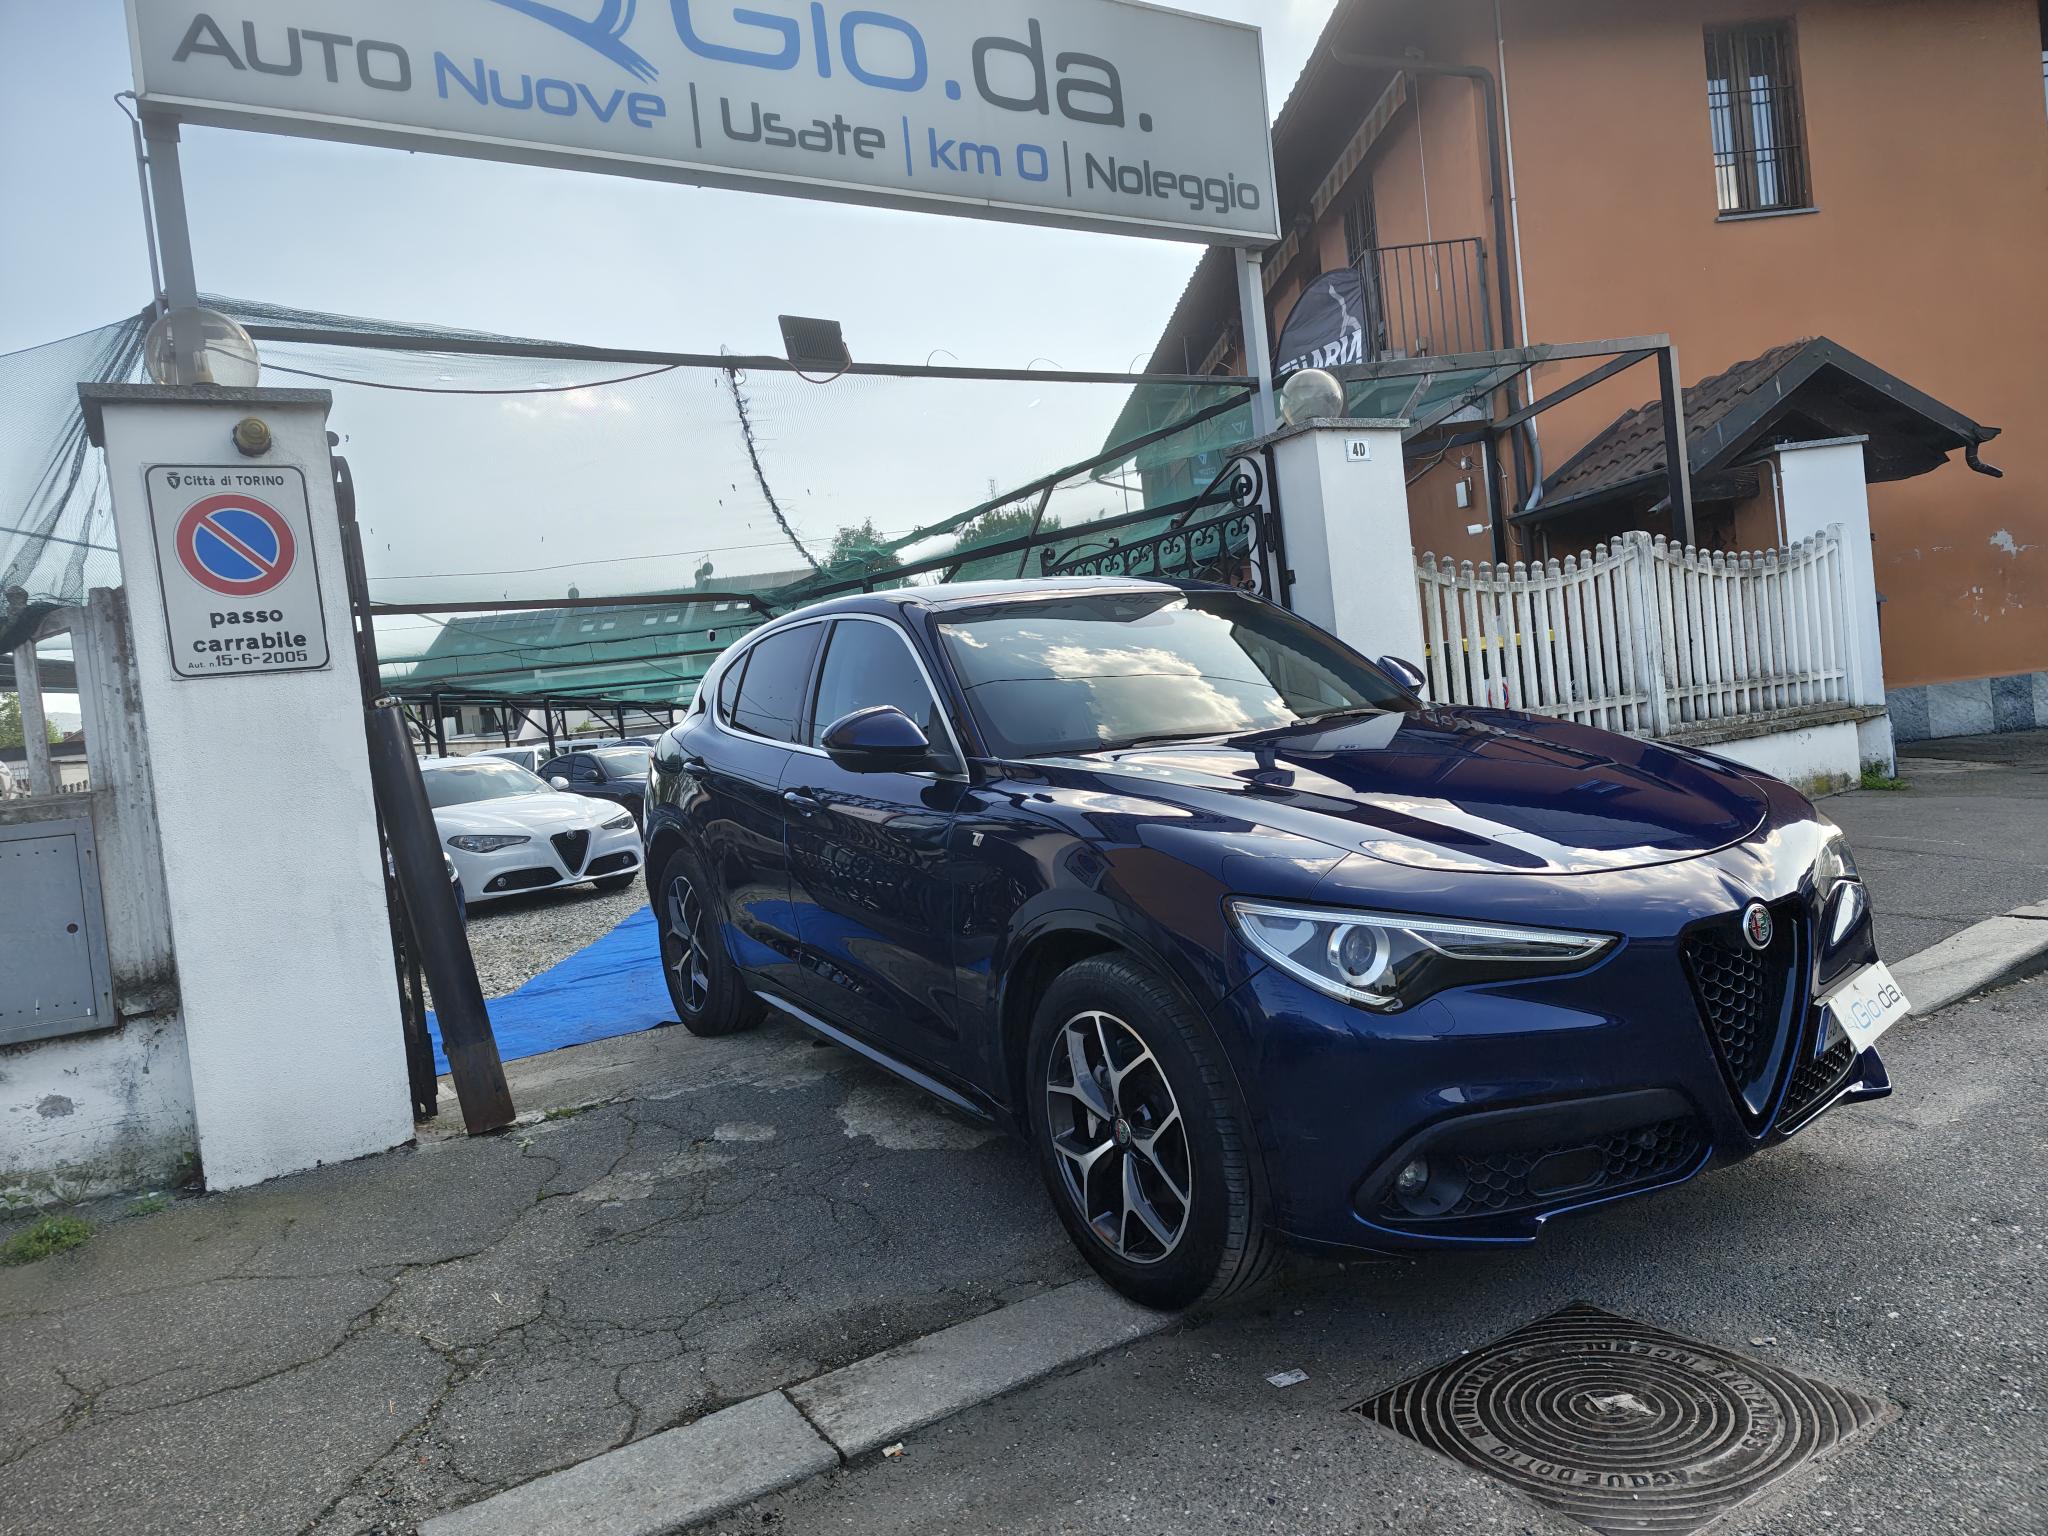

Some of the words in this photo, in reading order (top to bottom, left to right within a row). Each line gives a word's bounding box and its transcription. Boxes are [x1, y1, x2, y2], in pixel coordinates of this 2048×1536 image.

[172, 13, 412, 92] AUTO
[433, 51, 667, 129] Nuove
[719, 97, 886, 160] Usate
[928, 127, 1002, 178] km
[1085, 152, 1260, 214] Noleggio
[1352, 442, 1366, 456] 4D
[221, 475, 232, 486] di
[235, 475, 284, 486] TORINO
[209, 609, 284, 628] passo
[192, 631, 307, 653] carrabile
[188, 661, 206, 669] Aut.
[216, 650, 308, 667] 15-6-2005
